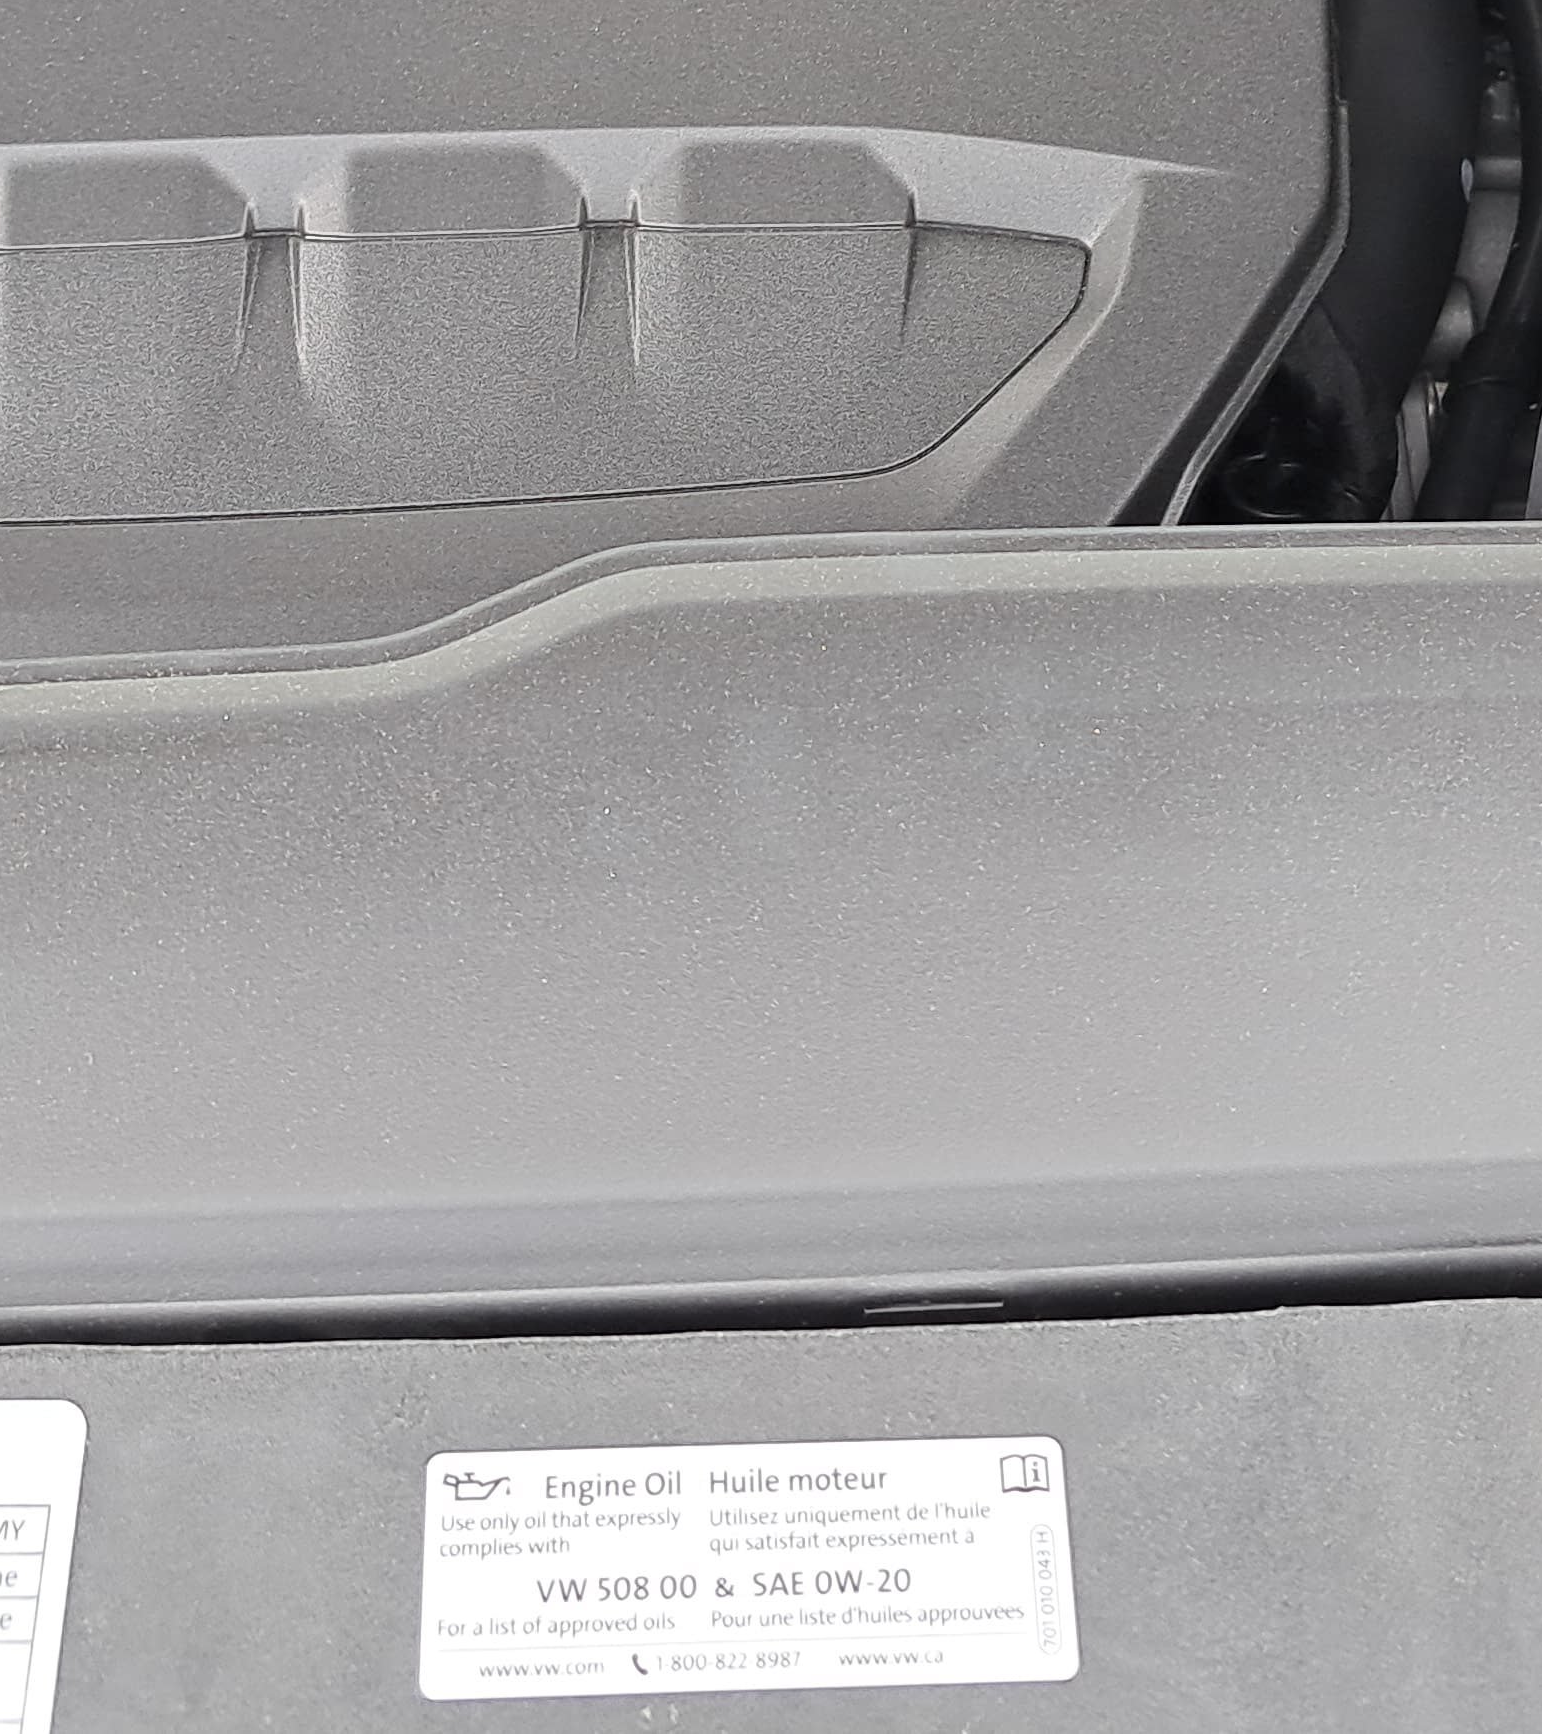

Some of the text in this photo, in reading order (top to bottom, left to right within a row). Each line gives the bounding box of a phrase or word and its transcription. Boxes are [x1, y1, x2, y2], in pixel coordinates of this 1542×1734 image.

[545, 1469, 682, 1506] Engine Oil
[709, 1466, 888, 1494] Huile moteur
[440, 1507, 681, 1535] Use only oil that expressly
[709, 1499, 991, 1528] Utilisez uniquement de l'huile
[440, 1536, 571, 1560] complies with
[709, 1536, 741, 1557] qui
[745, 1531, 820, 1552] satisfait
[536, 1567, 912, 1604] VW 508 00 & SAE 0W-20
[711, 1609, 752, 1628] Pour
[759, 1612, 794, 1627] une
[798, 1607, 837, 1627] liste
[841, 1605, 913, 1626] d'huiles
[1040, 1586, 1056, 1619] 010
[437, 1612, 676, 1638] For a list of approved oils
[479, 1659, 605, 1678] www.vw.com
[839, 1649, 944, 1667] www.vw.ca
